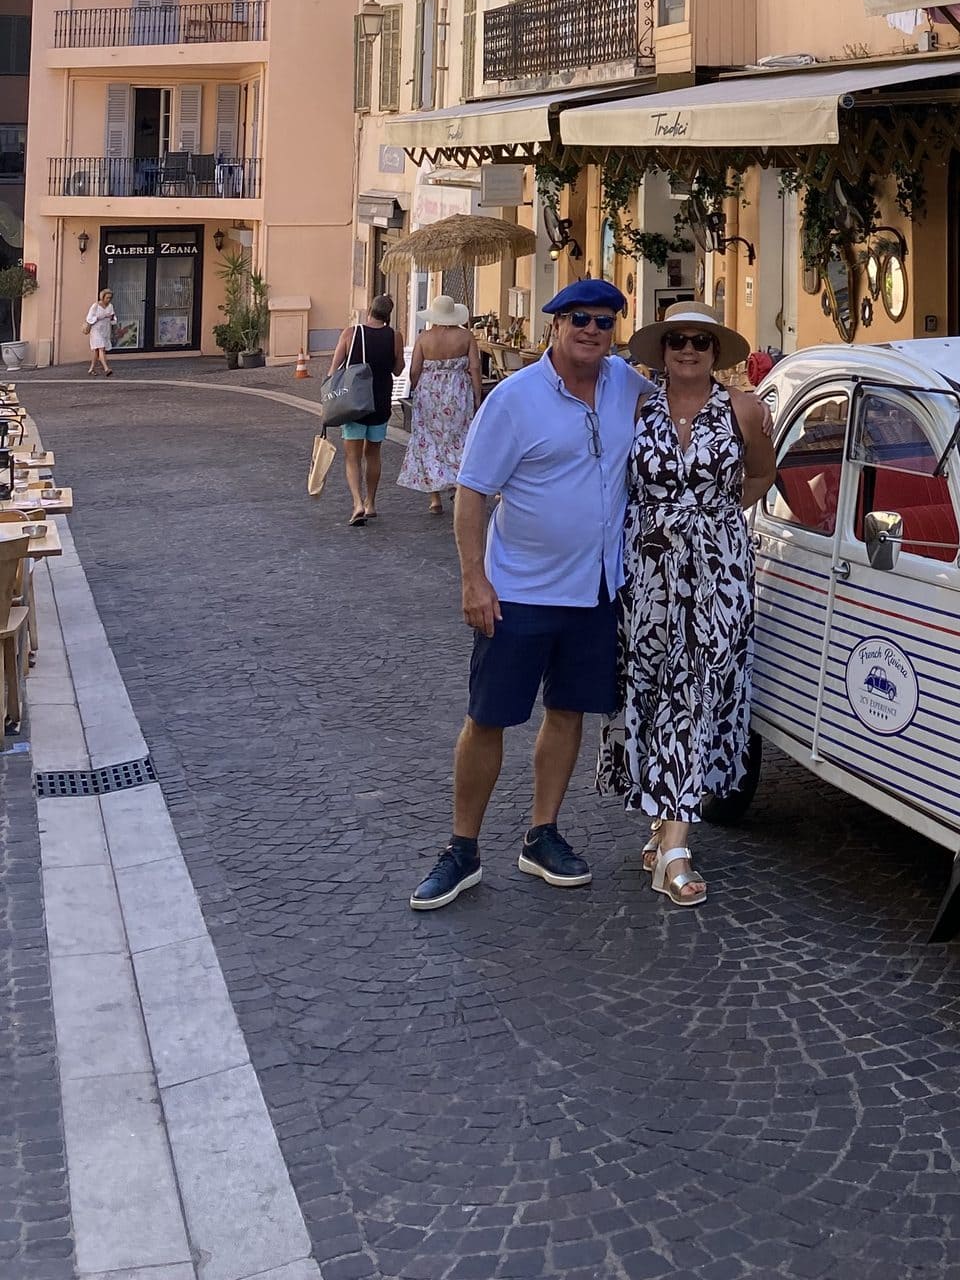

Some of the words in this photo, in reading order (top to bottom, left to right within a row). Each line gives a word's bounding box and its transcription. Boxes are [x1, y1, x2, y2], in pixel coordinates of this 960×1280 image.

[650, 111, 689, 137] Tredici
[859, 646, 882, 664] French
[884, 648, 908, 679] Riviera
